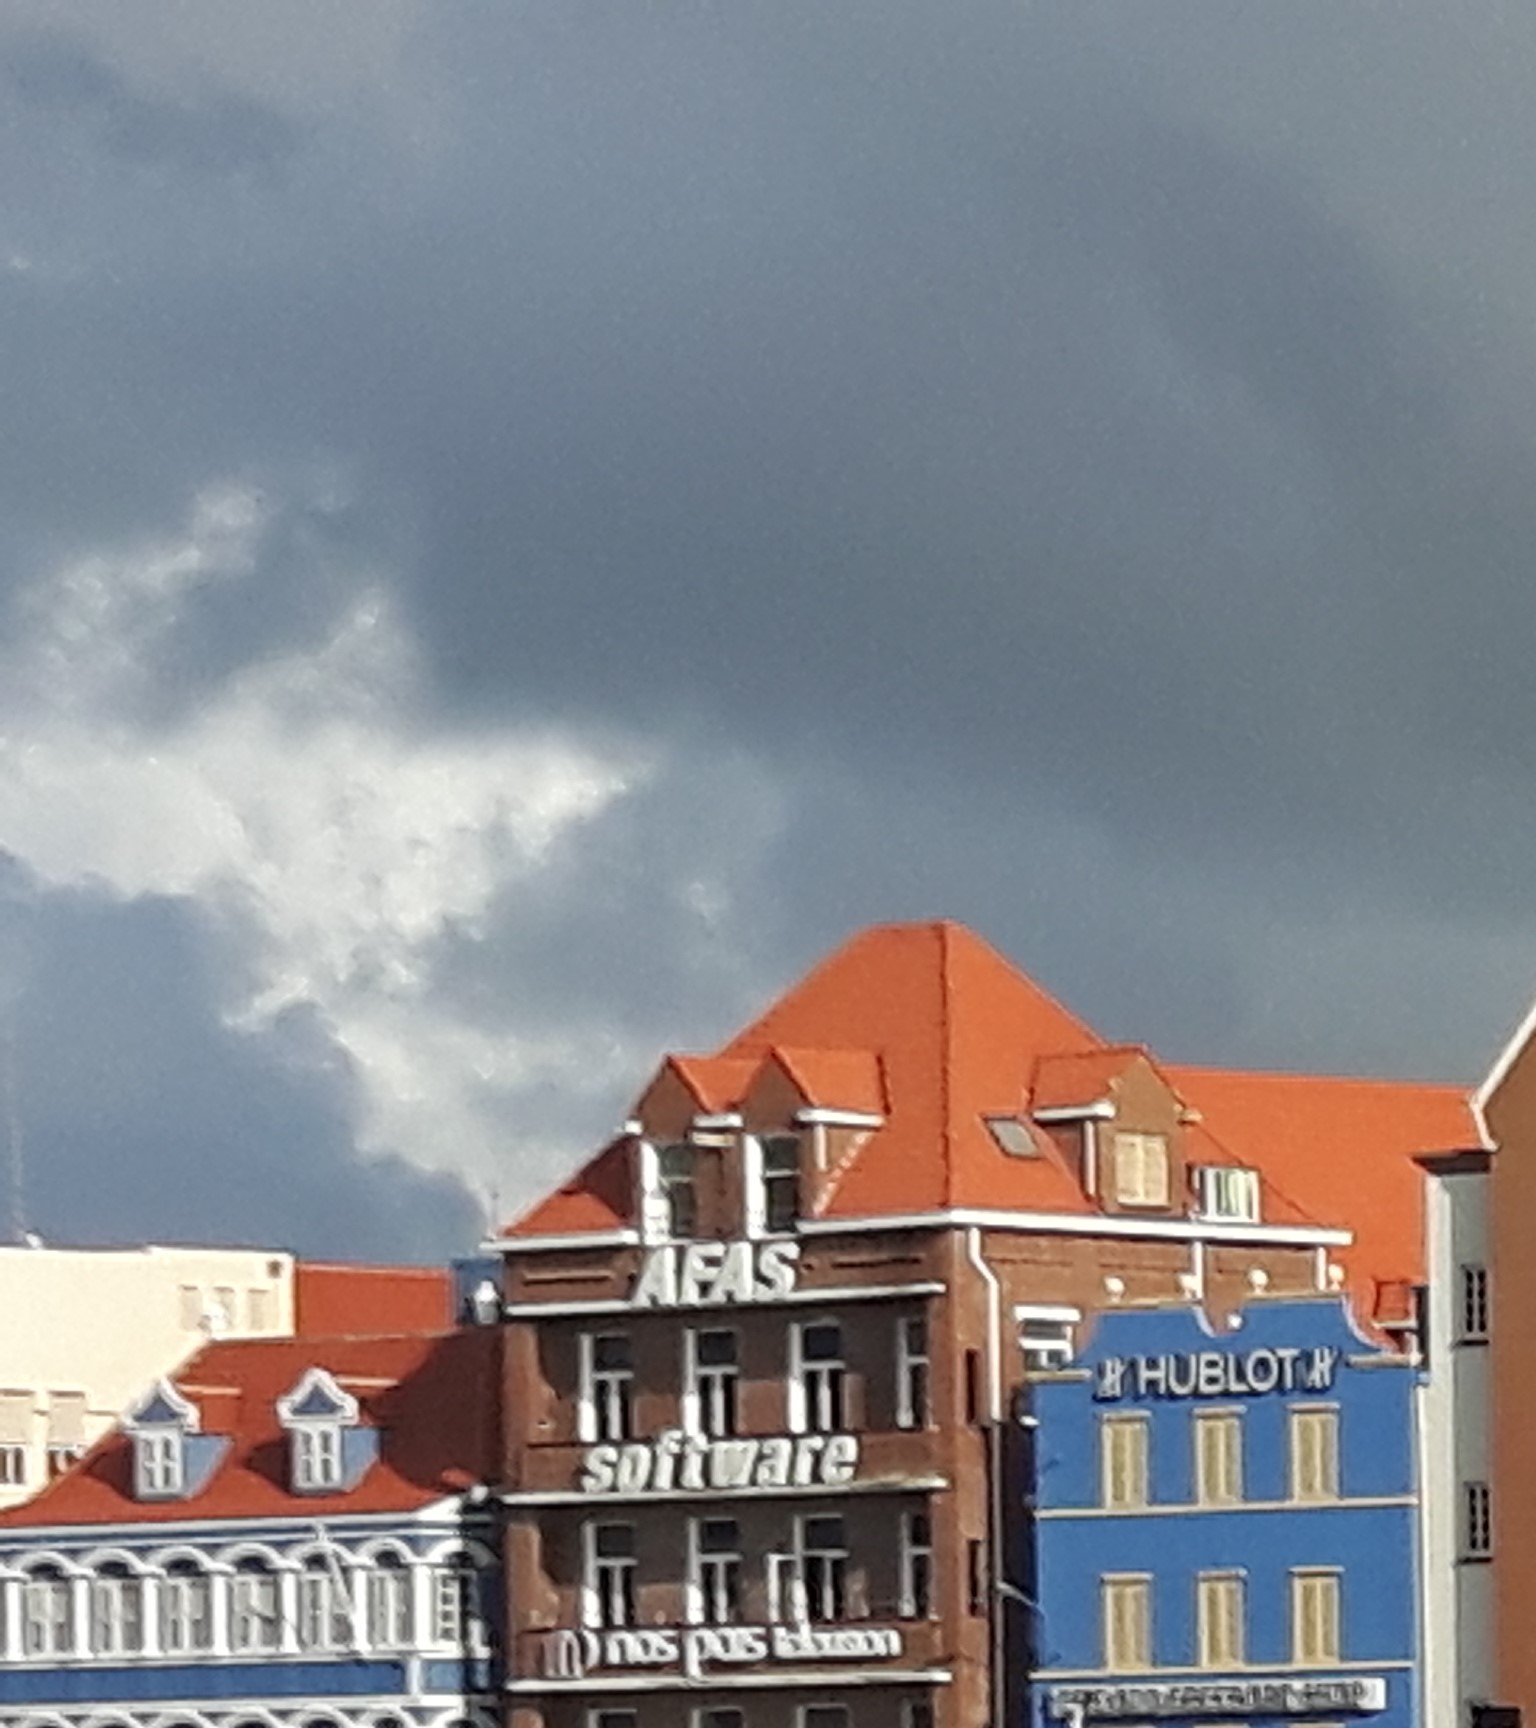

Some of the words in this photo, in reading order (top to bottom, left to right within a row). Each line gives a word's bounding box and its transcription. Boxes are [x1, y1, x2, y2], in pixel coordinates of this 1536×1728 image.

[632, 1241, 801, 1303] AFAS
[1137, 1349, 1299, 1397] HUBLOT
[582, 1430, 858, 1493] software
